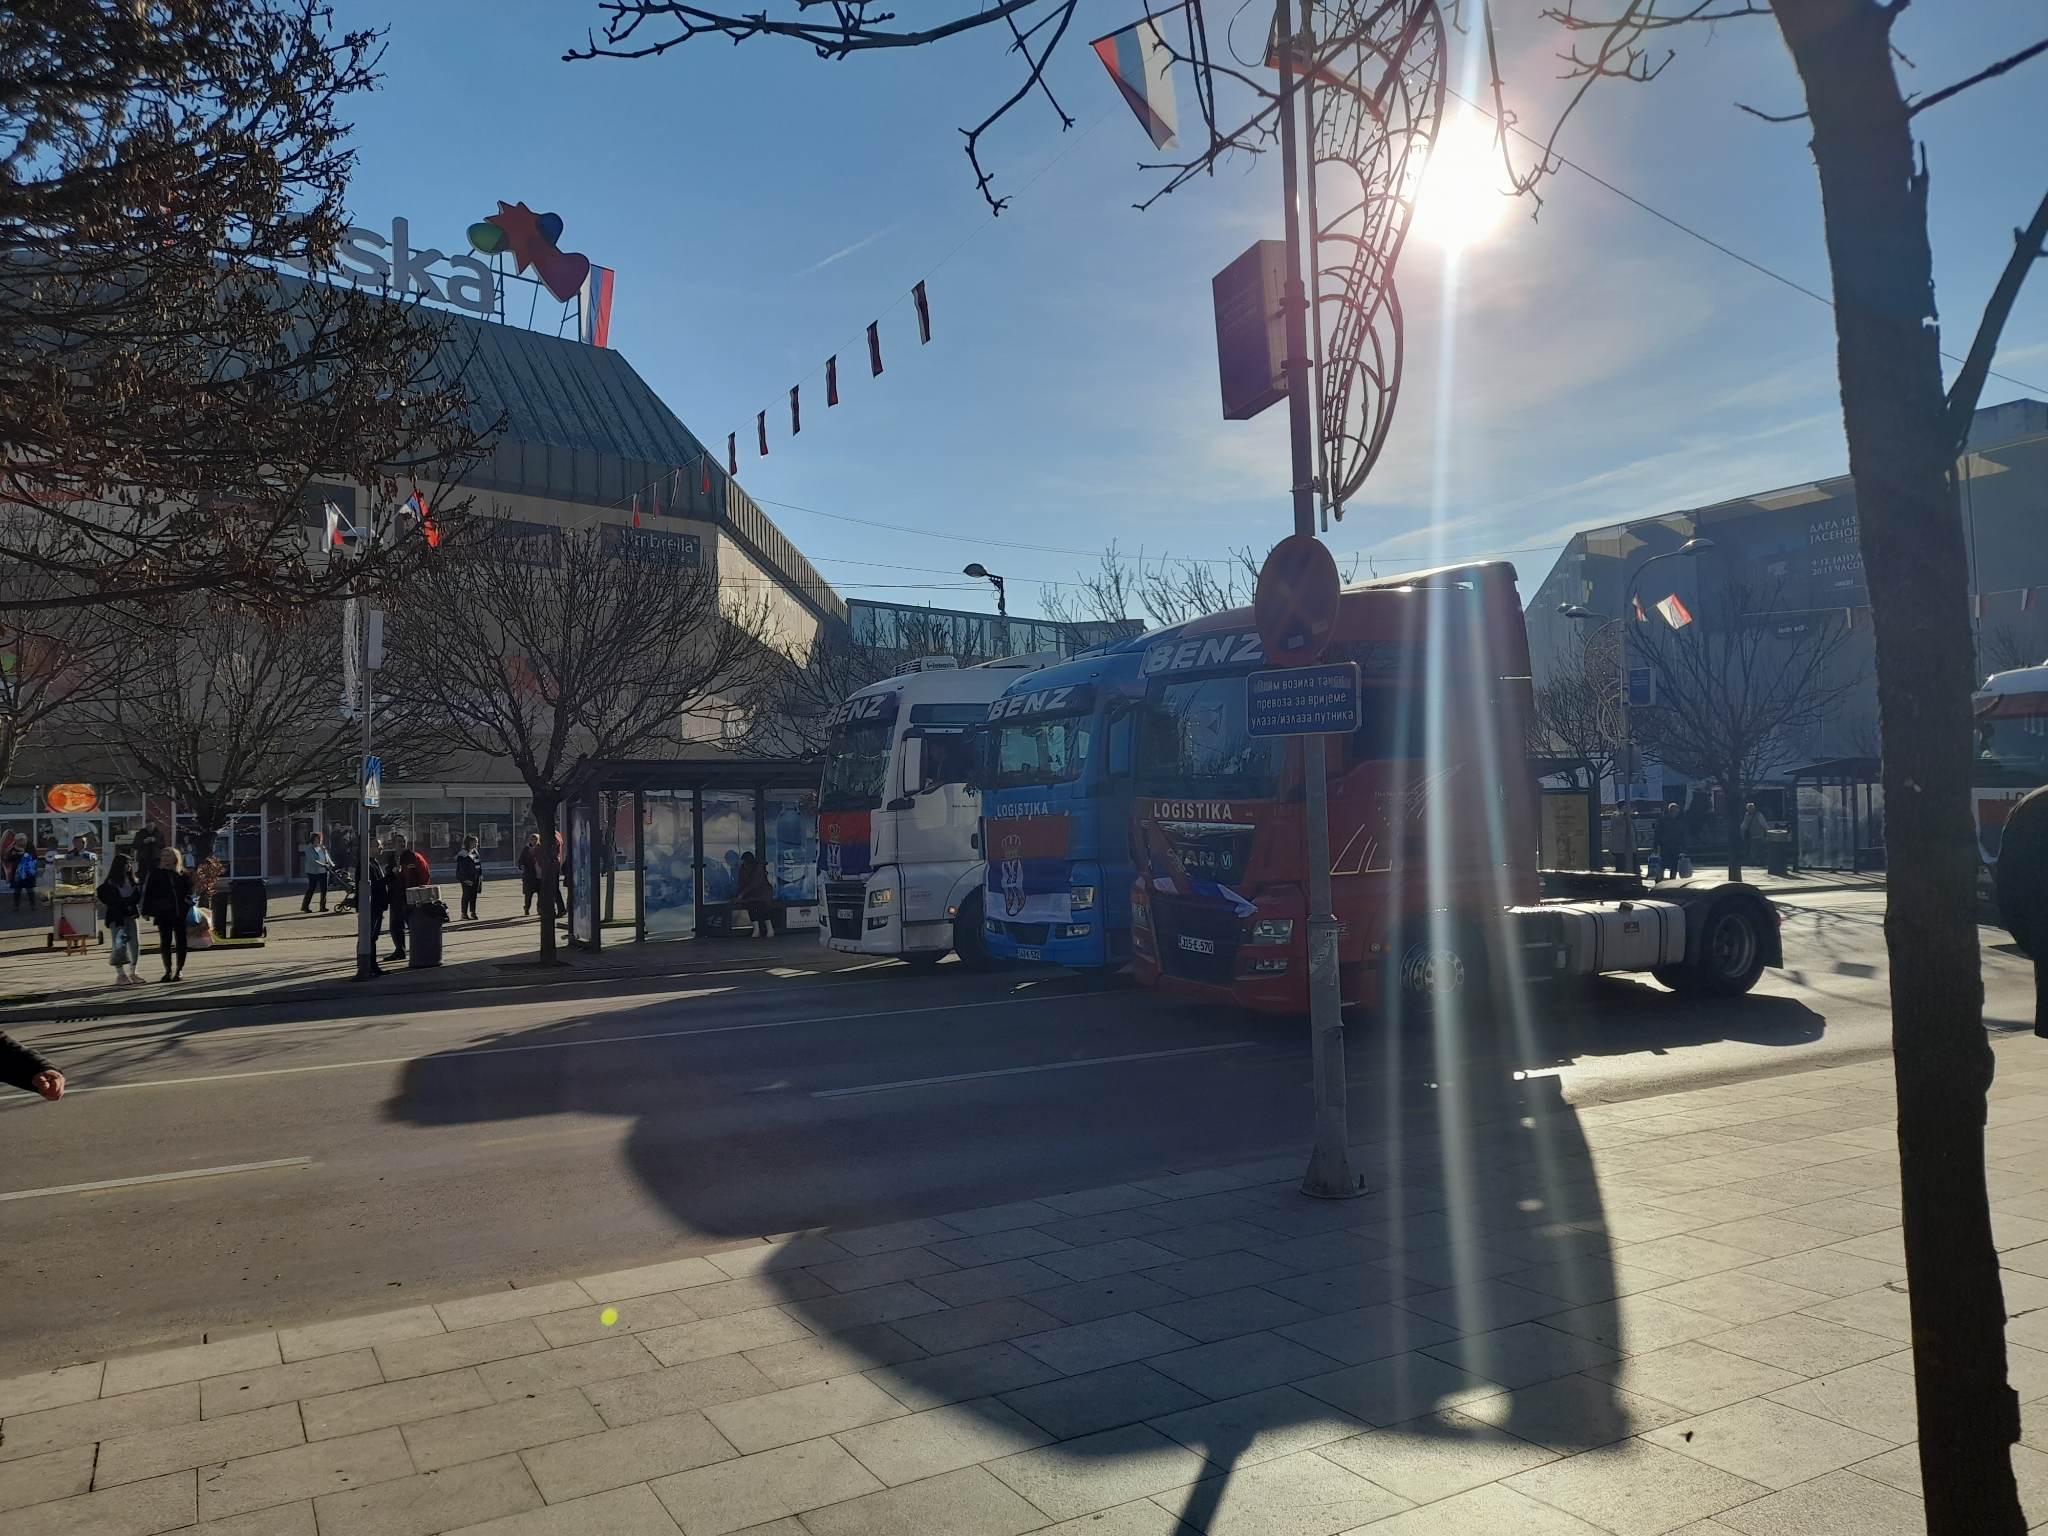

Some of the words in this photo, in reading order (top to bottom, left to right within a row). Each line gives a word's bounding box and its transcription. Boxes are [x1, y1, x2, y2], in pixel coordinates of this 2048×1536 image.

[1143, 631, 1264, 675] BENZ
[1282, 678, 1314, 690] возила
[821, 693, 888, 728] BENZ
[987, 685, 1076, 722] BENZ
[1256, 696, 1292, 712] превоза
[1295, 694, 1306, 706] за
[1308, 692, 1347, 708] вријеме
[1314, 709, 1354, 724] путника
[996, 801, 1049, 817] LOGISTIKA
[1153, 802, 1232, 820] LOGISTIKA
